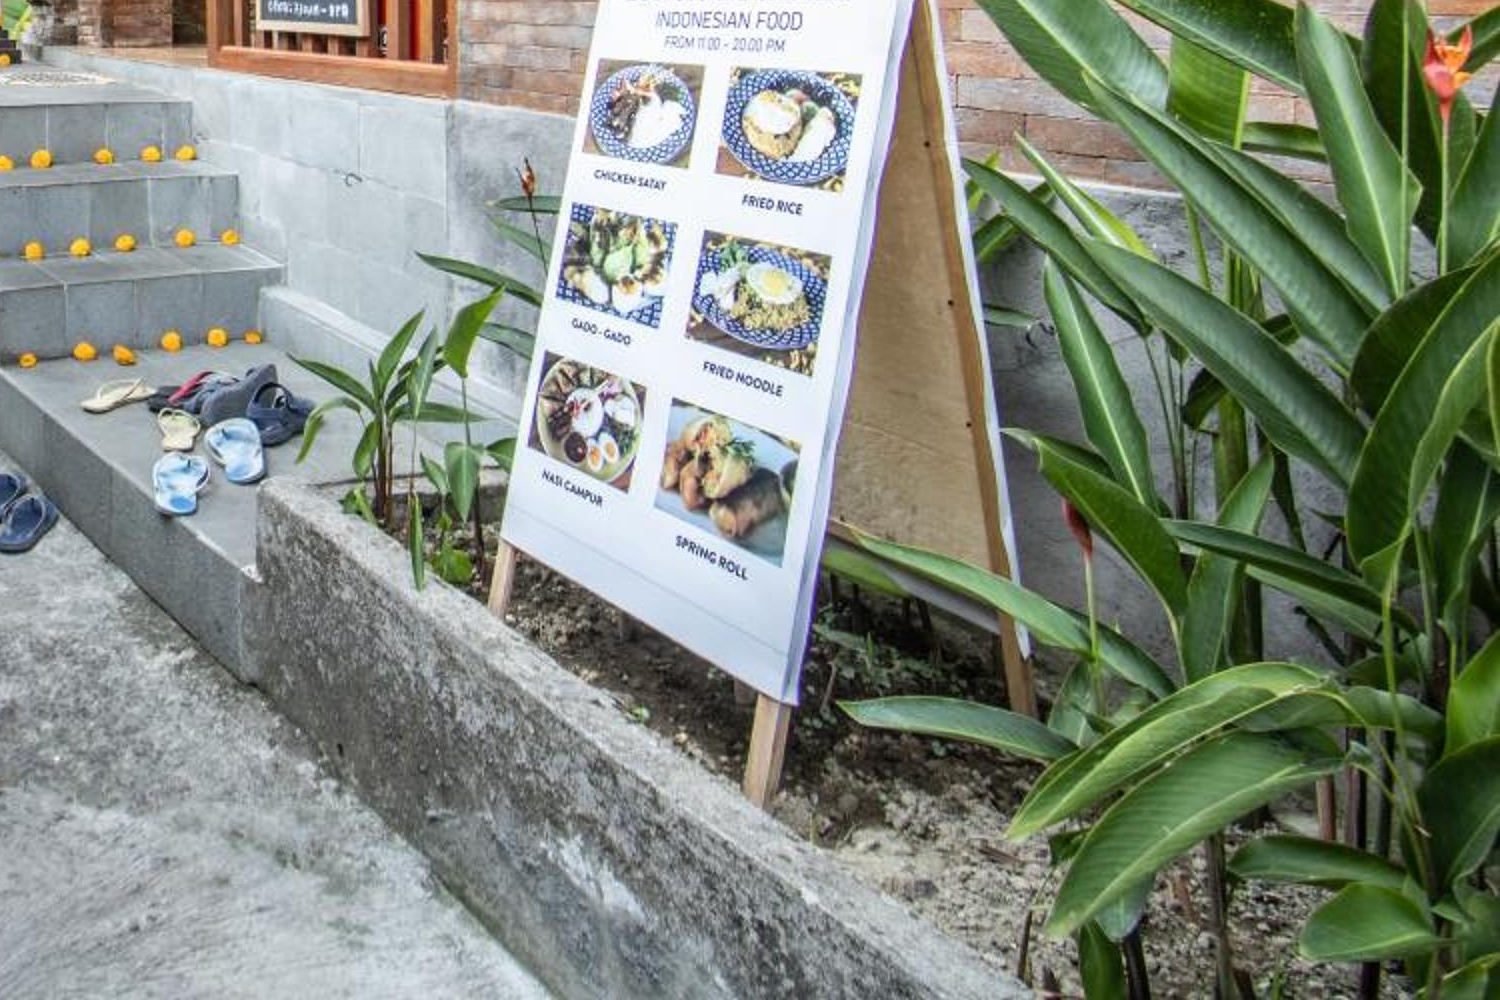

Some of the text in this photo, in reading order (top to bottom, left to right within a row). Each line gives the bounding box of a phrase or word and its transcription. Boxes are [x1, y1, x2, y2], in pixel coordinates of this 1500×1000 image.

[655, 11, 803, 31] INDONESIAN FOOD
[664, 35, 695, 49] FROM
[766, 38, 786, 53] PM
[593, 169, 637, 185] CHICKEN
[741, 193, 803, 216] FRIED RICE
[571, 318, 598, 336] GADO
[603, 328, 632, 346] GADO
[703, 361, 784, 397] FRIED NOODLE
[541, 469, 604, 507] NASI CAMPUR
[675, 535, 749, 580] SPRING ROLL
